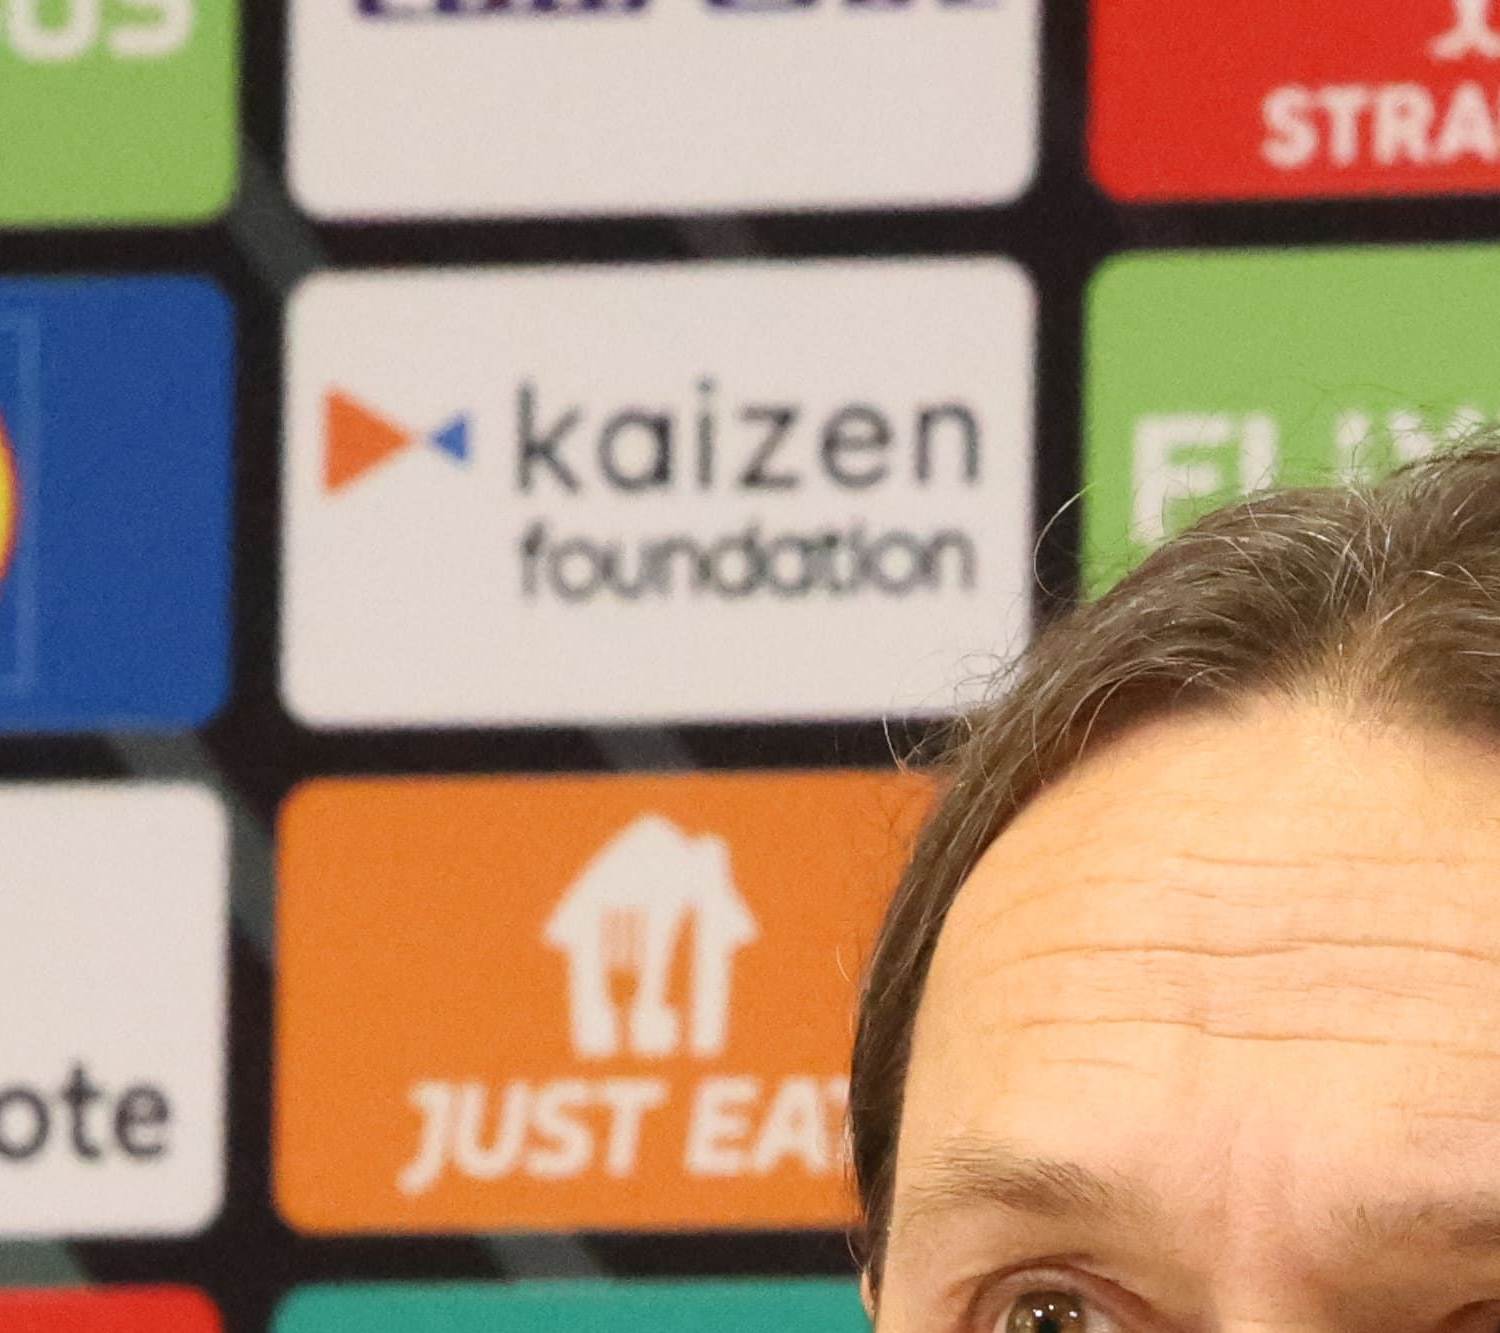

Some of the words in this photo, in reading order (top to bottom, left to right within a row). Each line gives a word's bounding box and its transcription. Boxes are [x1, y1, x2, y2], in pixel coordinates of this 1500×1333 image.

[516, 380, 981, 495] kaizen
[518, 520, 977, 604] foundation
[398, 1077, 669, 1196] JUST
